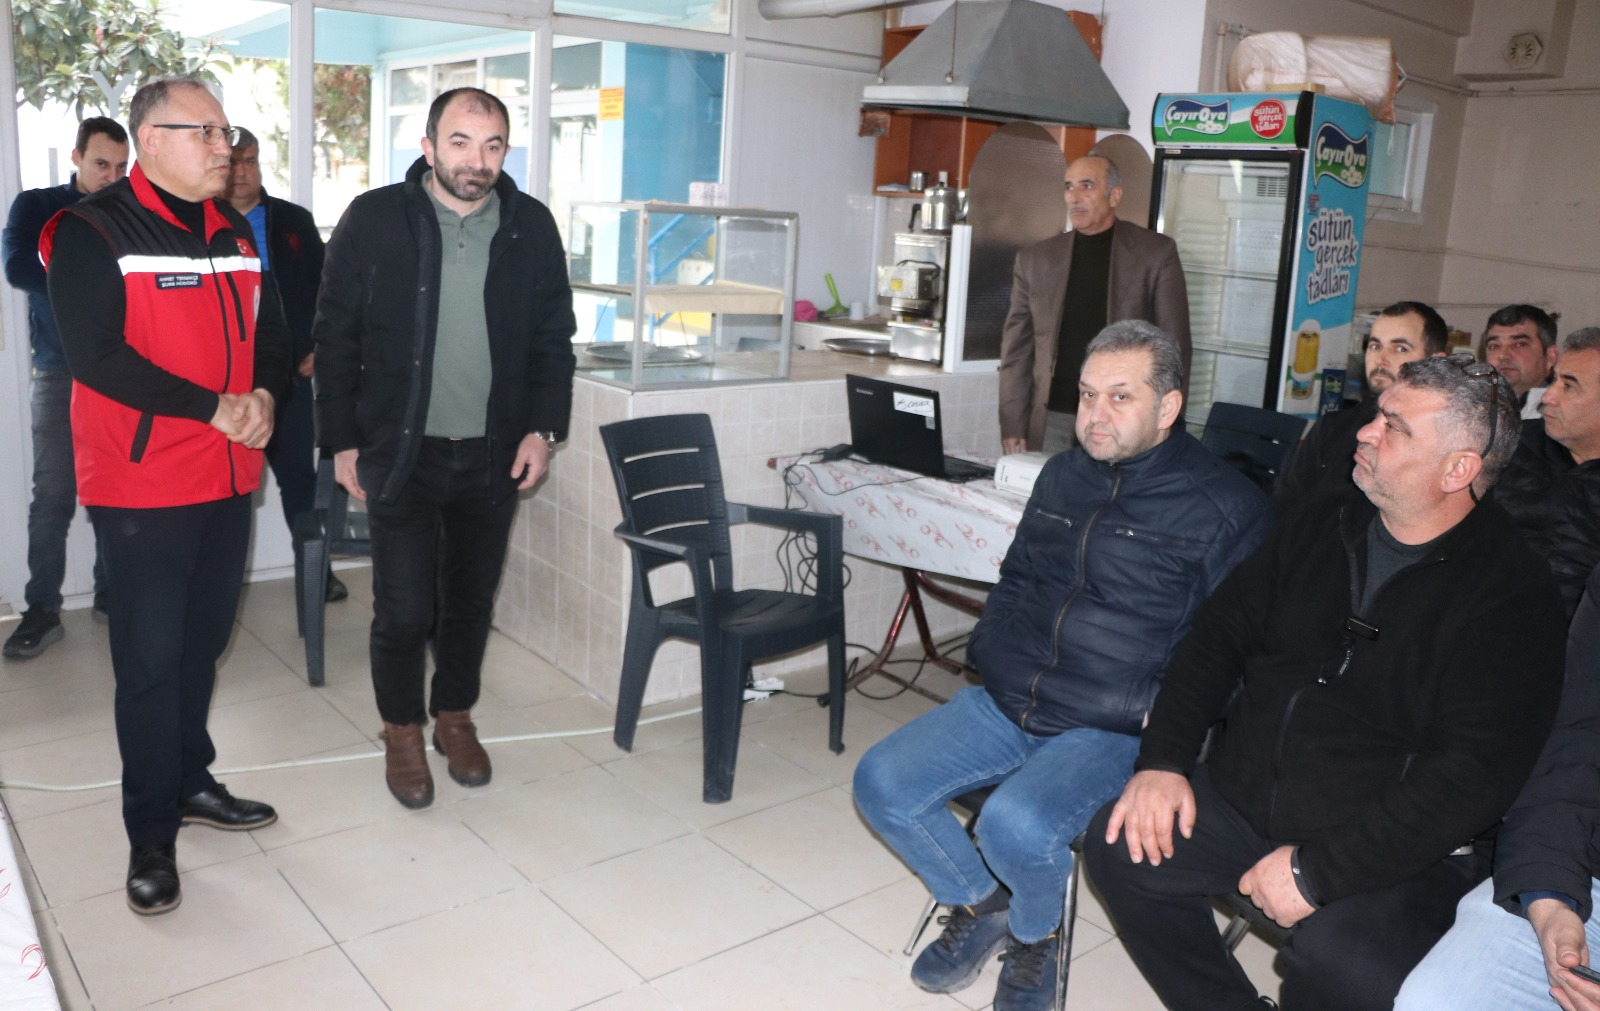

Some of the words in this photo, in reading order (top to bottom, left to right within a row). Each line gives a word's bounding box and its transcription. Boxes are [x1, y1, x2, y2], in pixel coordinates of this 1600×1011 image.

[1254, 105, 1280, 116] sütün
[1258, 112, 1283, 125] gerçek
[1255, 121, 1280, 132] tadları
[1308, 211, 1352, 248] sütün
[1316, 239, 1358, 277] gerçek
[1308, 267, 1349, 301] tadları
